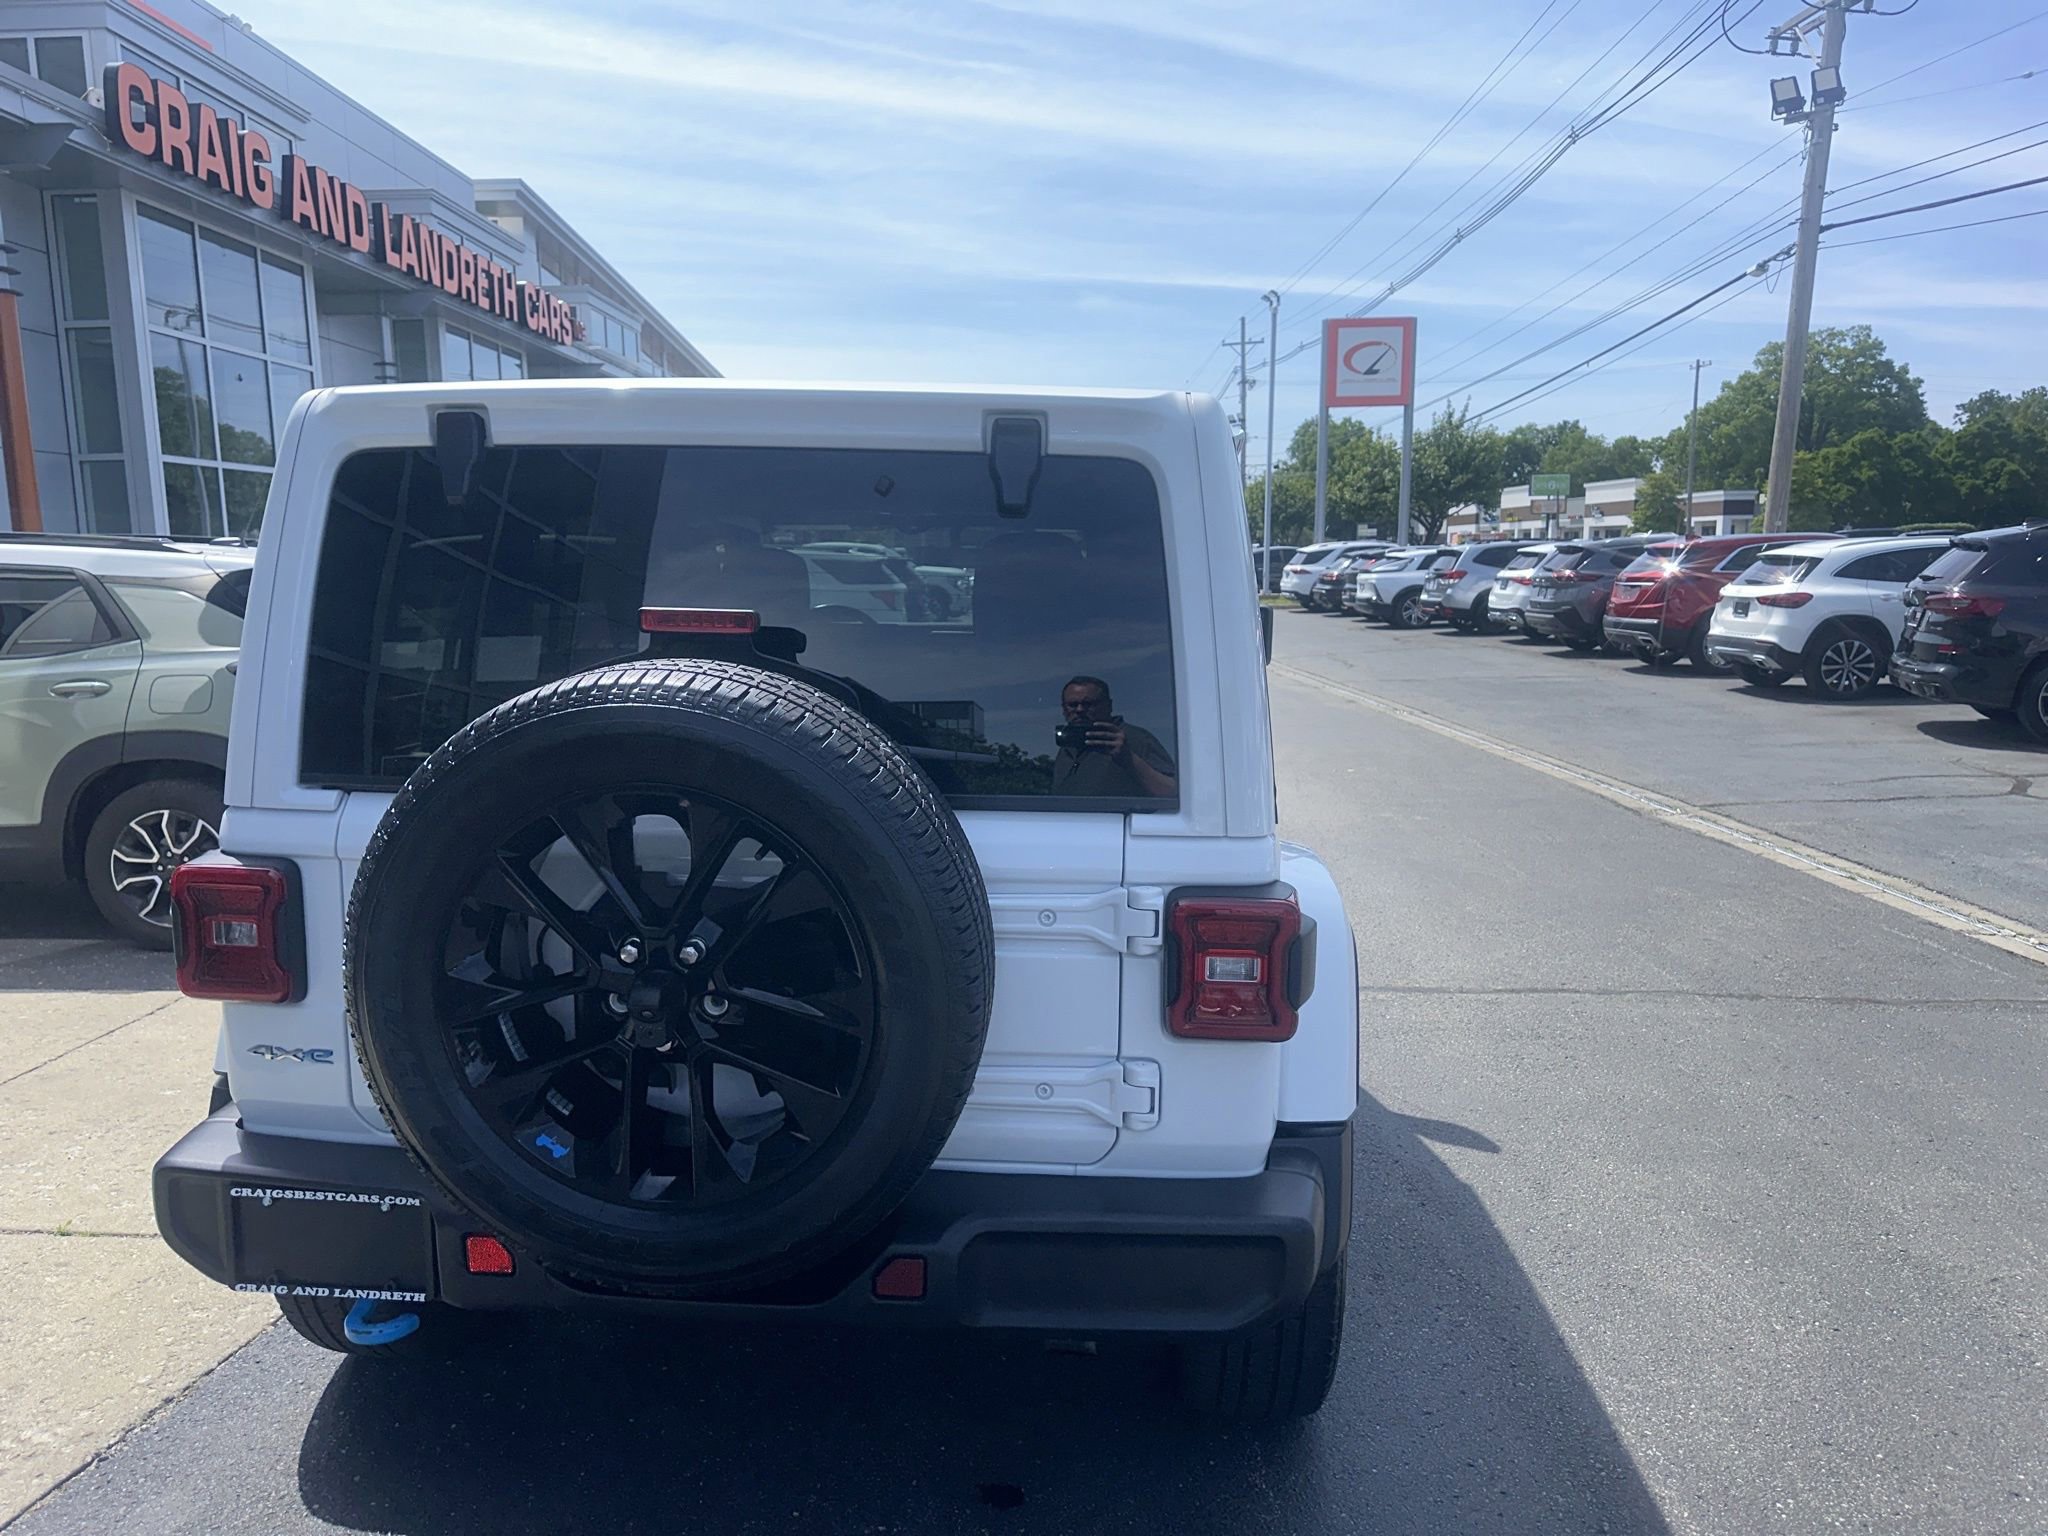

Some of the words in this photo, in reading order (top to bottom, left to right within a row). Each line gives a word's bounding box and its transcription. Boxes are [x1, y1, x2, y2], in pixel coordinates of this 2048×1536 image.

[115, 62, 274, 209] CRAIG
[291, 154, 369, 253] AND
[381, 202, 518, 322] LANDRETH
[523, 281, 573, 346] CARS
[230, 1187, 421, 1207] CRAIGSBESTCARS.COM
[234, 1283, 288, 1296] CRAIG
[292, 1286, 329, 1298] AND
[333, 1288, 426, 1303] LANDRETH
